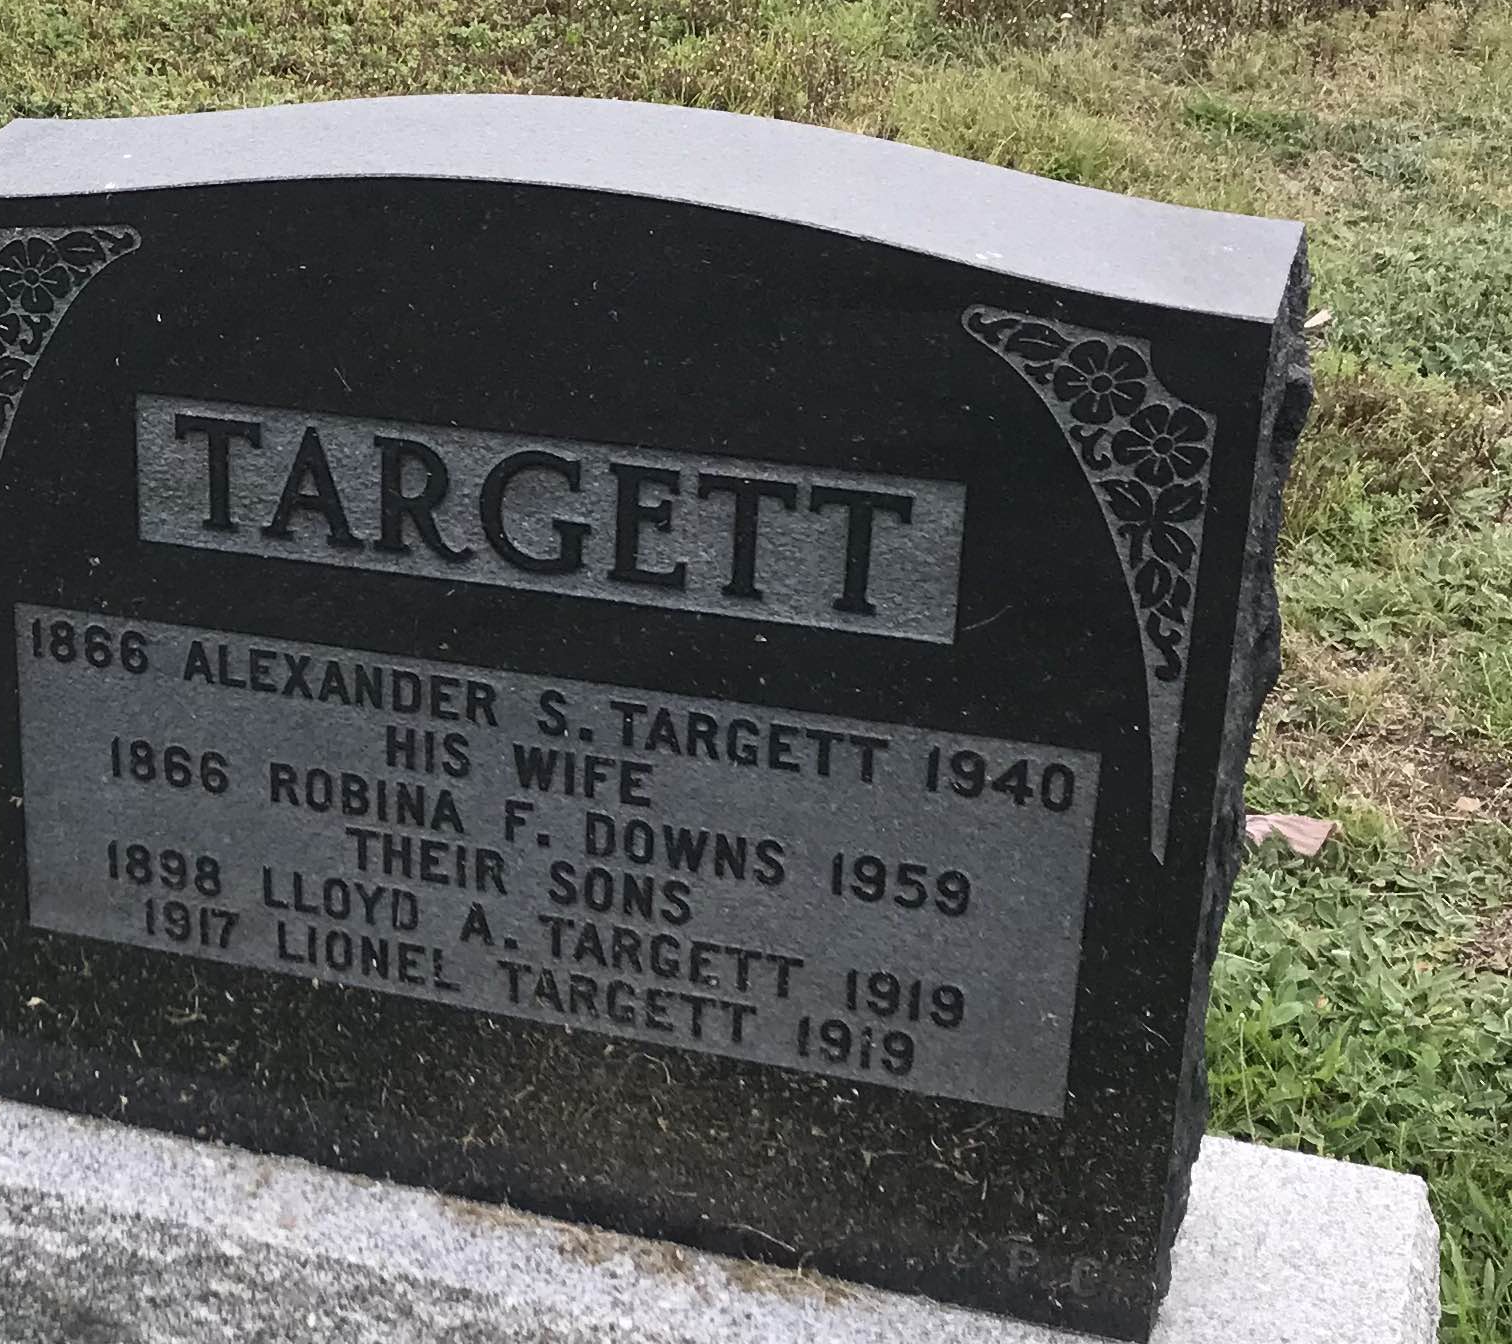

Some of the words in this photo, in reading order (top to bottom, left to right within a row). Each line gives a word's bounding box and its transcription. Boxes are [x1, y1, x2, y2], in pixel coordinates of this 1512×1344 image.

[174, 412, 914, 617] TARGETT
[31, 618, 149, 674] 1866
[184, 641, 498, 727] ALEXANDER
[537, 690, 594, 742] S.
[610, 700, 889, 784] TARGETT
[927, 746, 1075, 813] 1940
[386, 726, 470, 778] HIS
[512, 743, 653, 807] WIFE
[110, 736, 230, 795] 1866
[269, 762, 464, 834] ROBINA
[503, 800, 550, 848] F.
[587, 812, 786, 886] DOWNS
[832, 852, 971, 918] 1959
[345, 826, 509, 896] THEIR
[548, 860, 692, 926] SONS
[106, 839, 222, 898] 1898
[262, 865, 419, 931] LLOYD
[459, 902, 518, 950] A.
[539, 913, 804, 999] TARGETT
[846, 968, 965, 1029] 1919
[145, 898, 239, 949] 1917
[277, 921, 460, 993] LIONEL
[496, 961, 757, 1043] TARGETT
[798, 1016, 915, 1077] 1919
